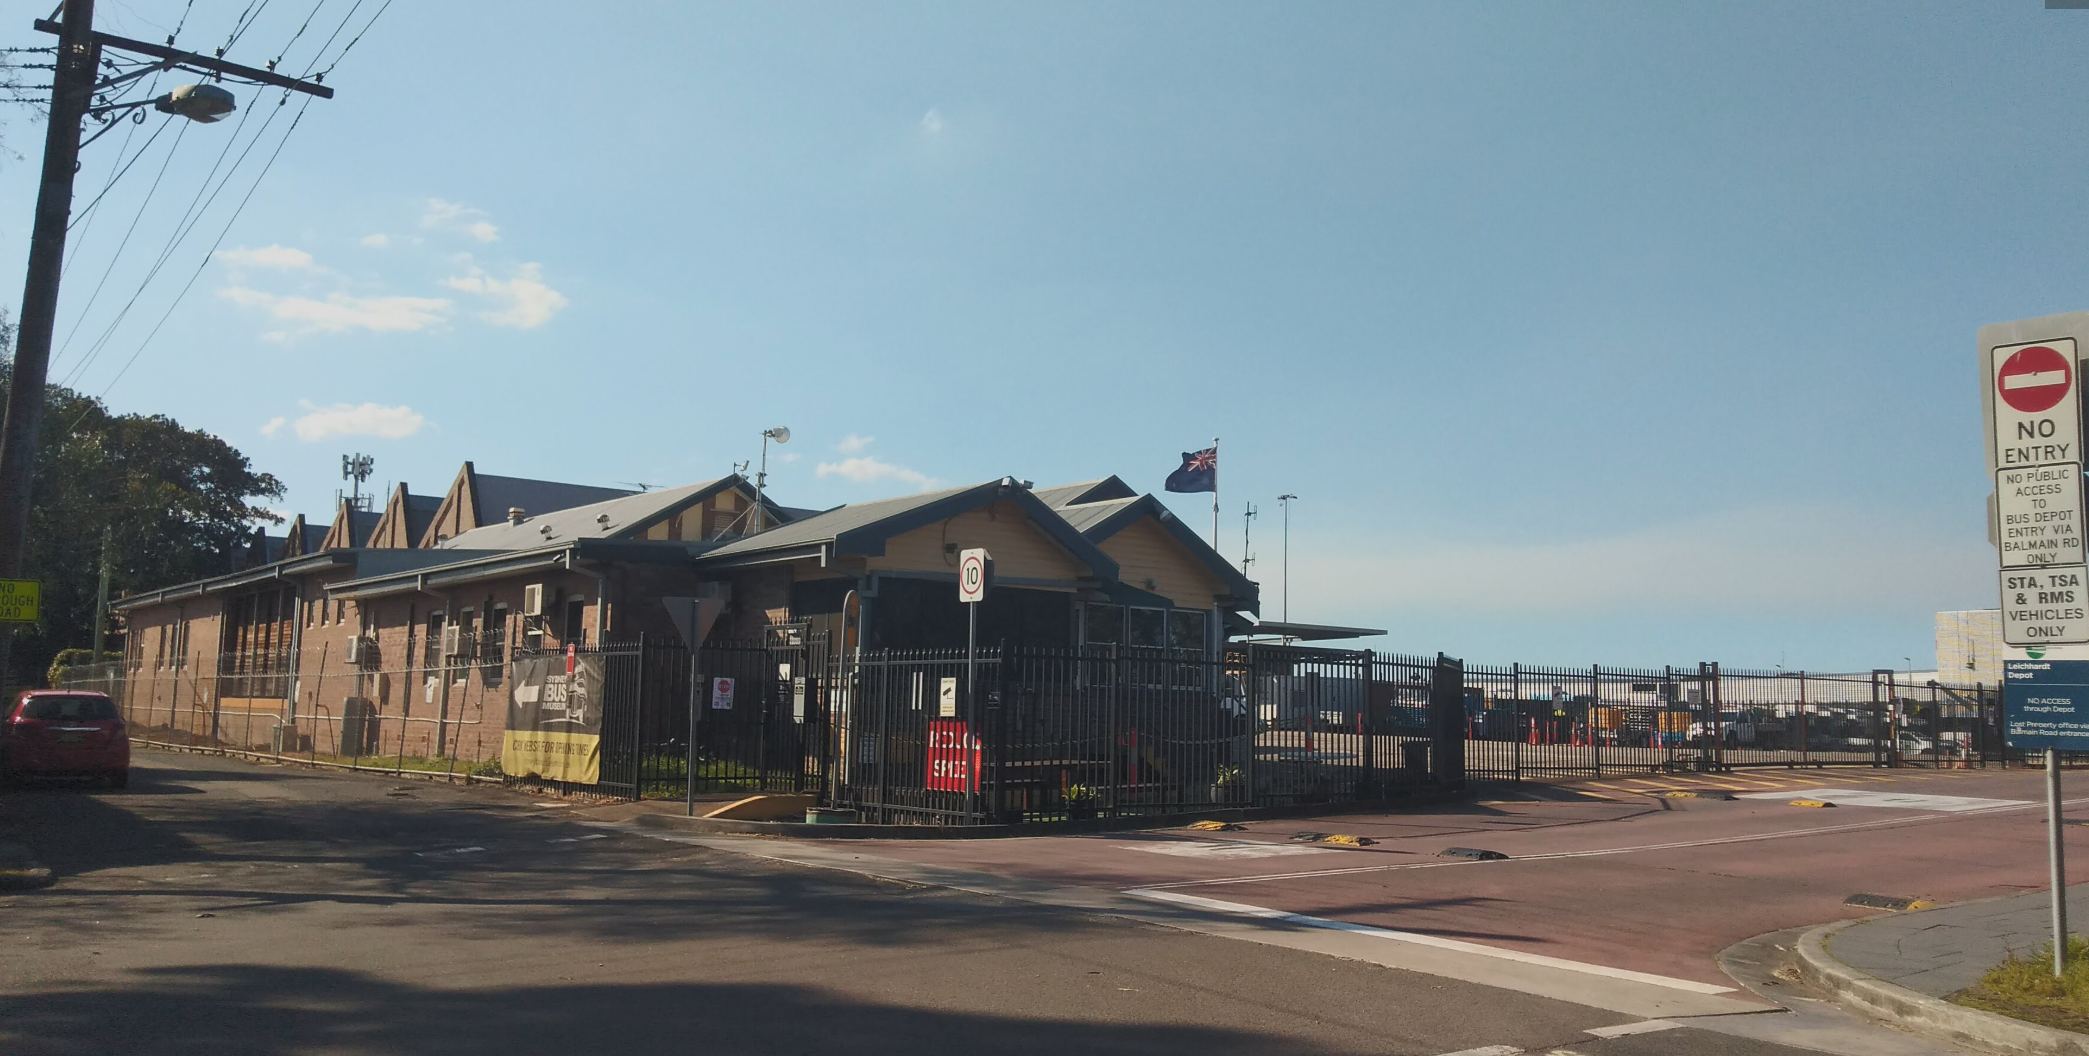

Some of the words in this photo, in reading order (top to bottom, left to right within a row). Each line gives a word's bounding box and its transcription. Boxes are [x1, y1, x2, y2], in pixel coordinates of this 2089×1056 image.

[2017, 418, 2056, 440] NO
[2005, 443, 2070, 464] ENTRY
[2006, 473, 2023, 484] NO
[2027, 469, 2069, 482] PUBLIC
[2015, 484, 2062, 497] ACCESS
[2031, 498, 2047, 509] TO
[2006, 513, 2030, 525] BUS
[2035, 510, 2074, 523] DEPOT
[2008, 525, 2047, 538] ENTRY
[2053, 524, 2073, 535] VIA
[2004, 538, 2058, 552] BALMAIN
[2063, 537, 2079, 548] RD
[2027, 552, 2058, 564] ONLY
[966, 566, 979, 585] 10
[2007, 576, 2044, 590] STA,
[2048, 574, 2080, 587] TSA
[0, 594, 34, 606] OUGH
[2015, 592, 2027, 605] &
[2038, 590, 2075, 604] RMS
[2008, 608, 2084, 621] VEHICLES
[2026, 625, 2066, 638] ONLY
[2008, 671, 2034, 680] Depot
[543, 683, 567, 702] BUS
[2027, 697, 2040, 705] NO
[2024, 705, 2052, 713] through
[2053, 705, 2075, 713] Depot
[2026, 721, 2056, 730] Property
[541, 741, 555, 753] FOR
[933, 759, 967, 778] SPEE
